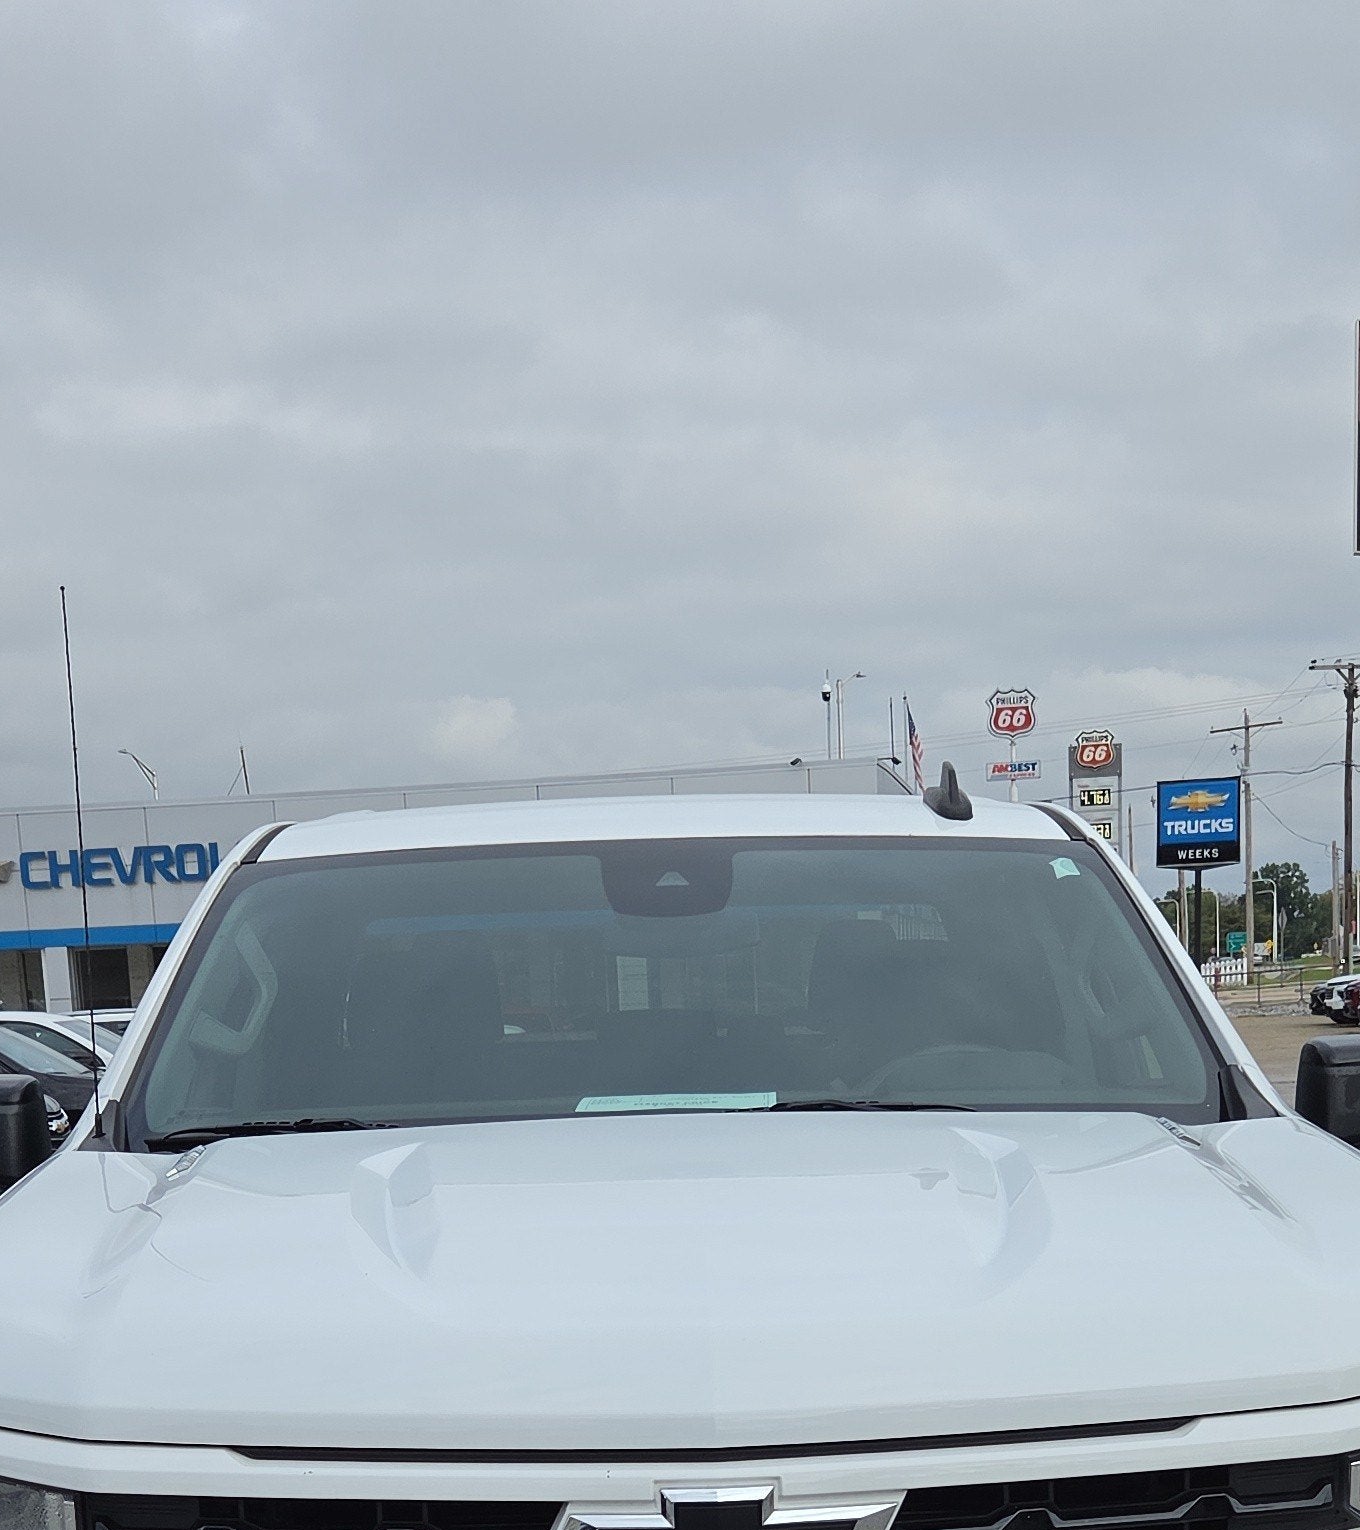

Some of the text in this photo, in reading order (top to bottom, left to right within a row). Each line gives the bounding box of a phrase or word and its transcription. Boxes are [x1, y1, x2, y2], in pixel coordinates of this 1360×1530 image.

[998, 708, 1027, 728] 66
[1082, 745, 1107, 762] 66
[1163, 818, 1234, 836] TRUCKS
[1177, 848, 1219, 860] WEEKS
